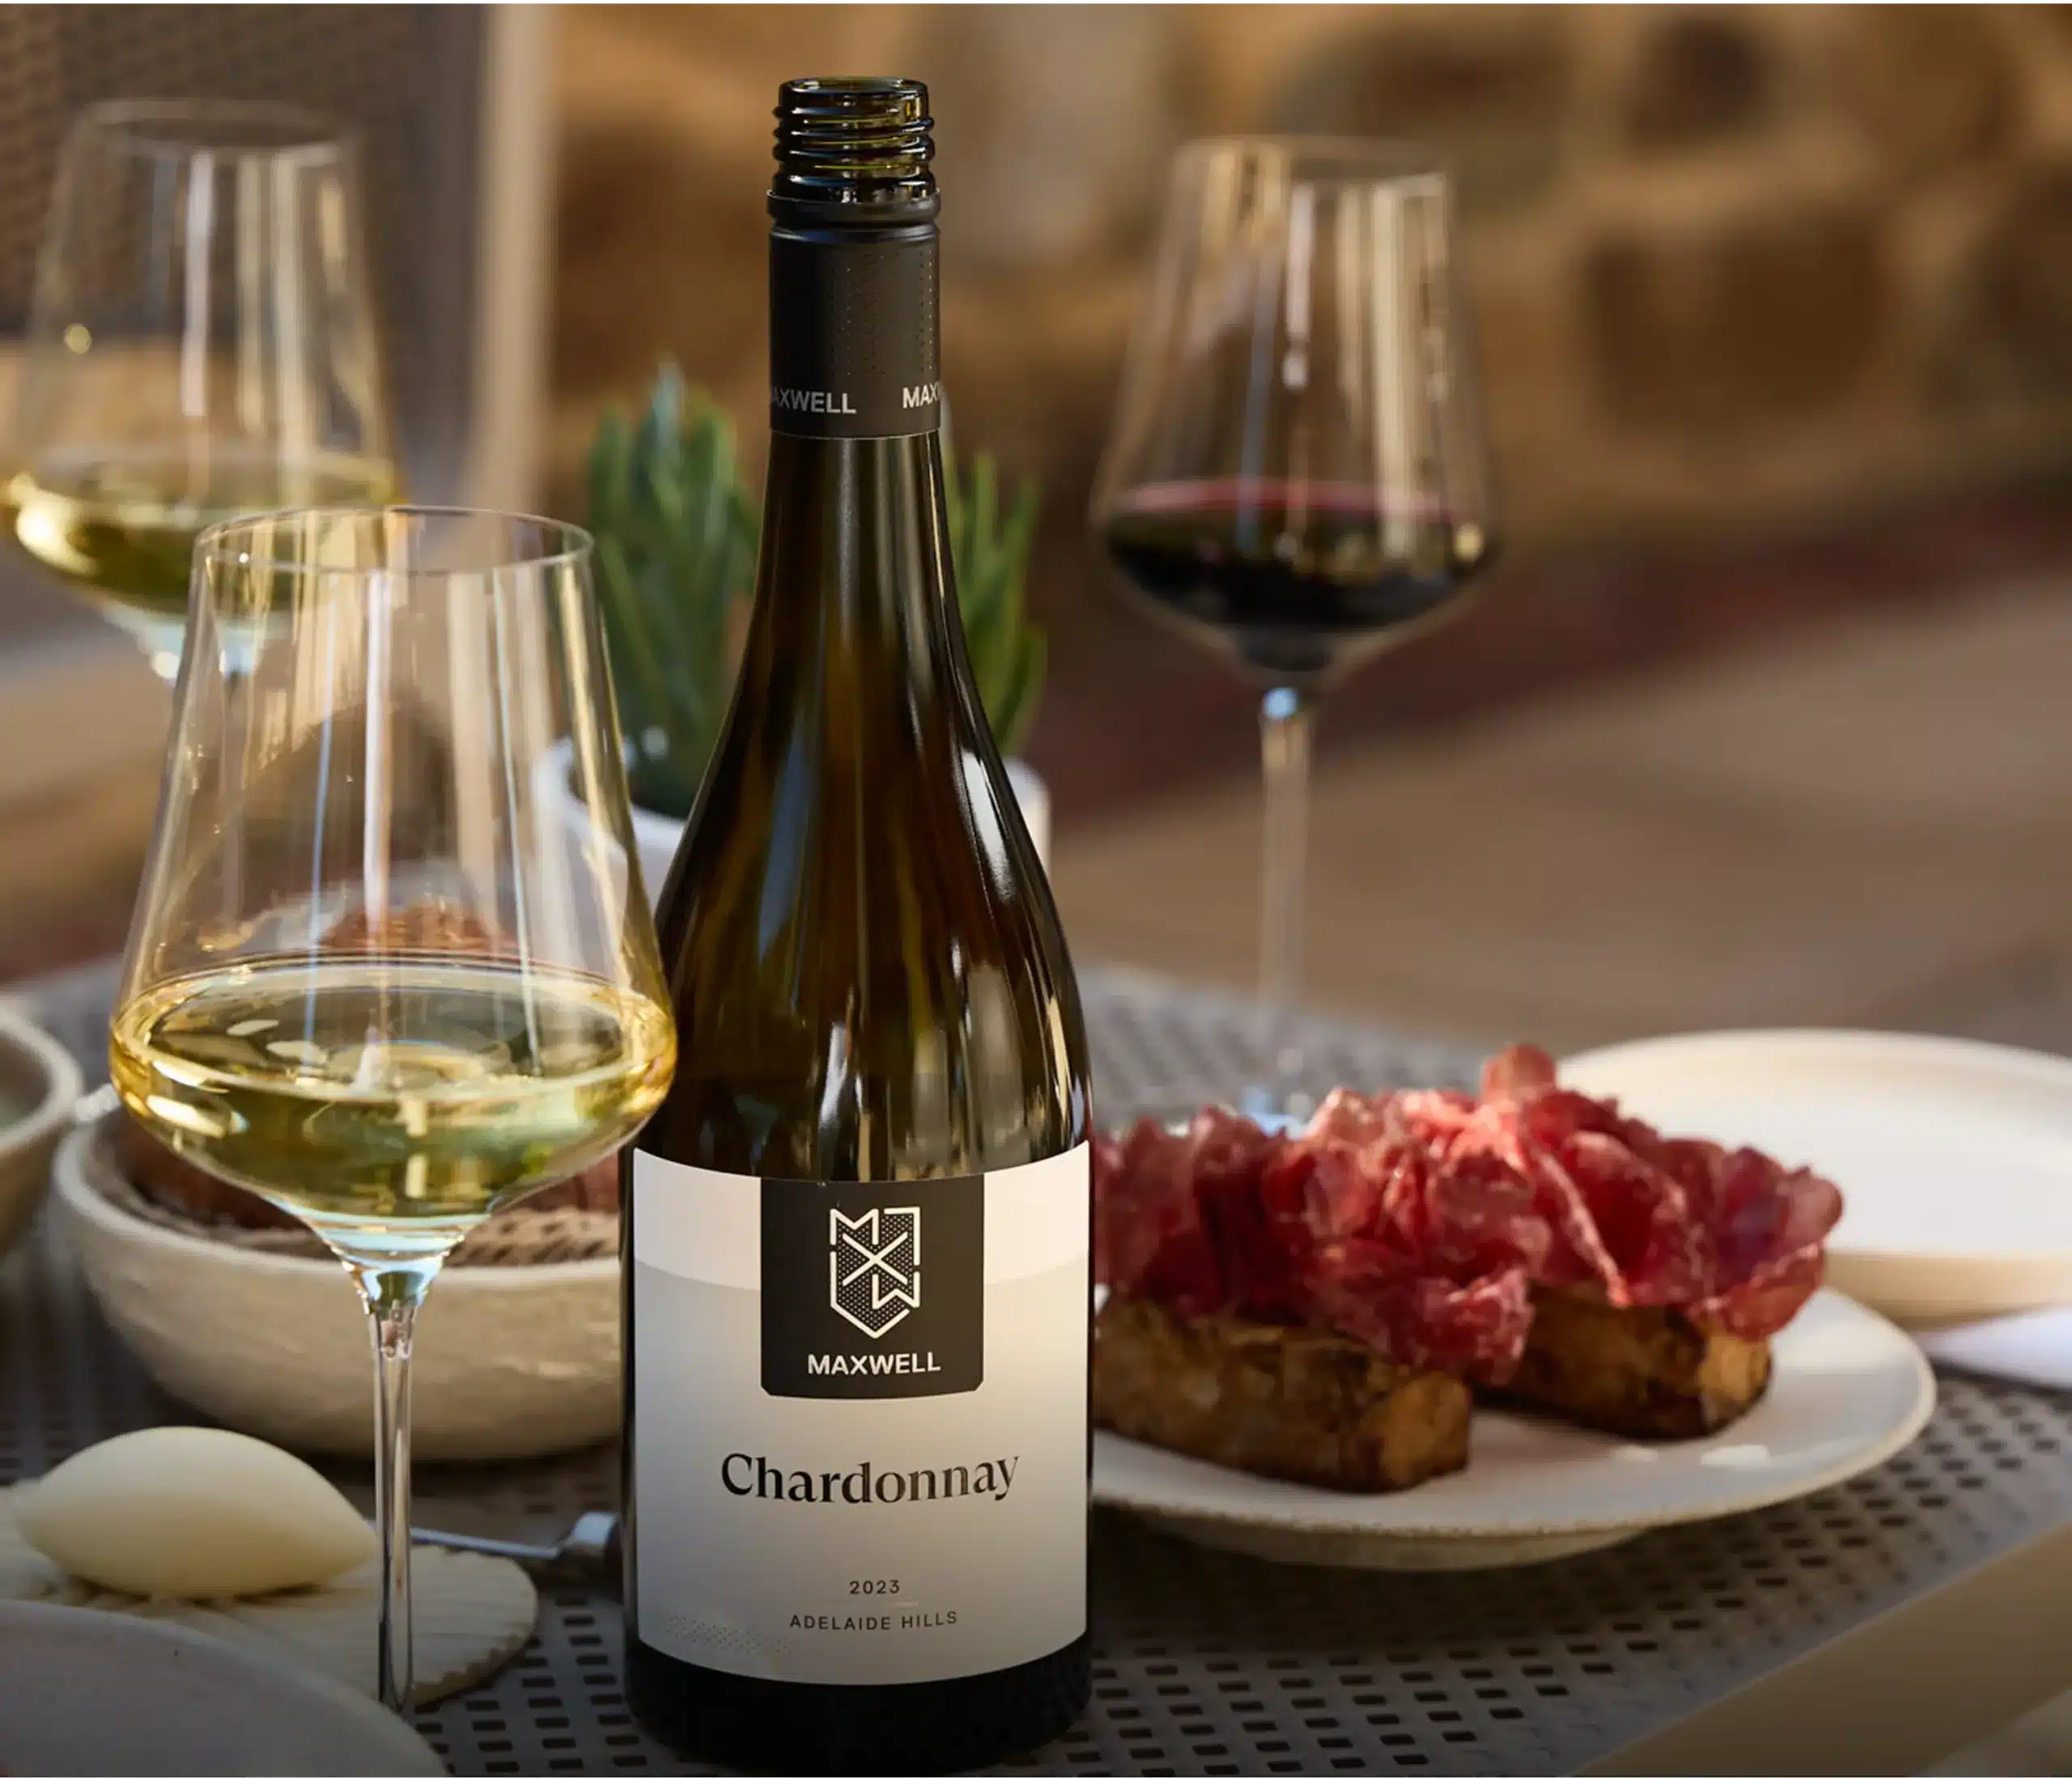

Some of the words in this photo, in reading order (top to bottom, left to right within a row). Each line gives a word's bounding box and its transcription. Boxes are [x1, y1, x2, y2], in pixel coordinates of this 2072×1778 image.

[771, 385, 857, 414] AXWELL
[808, 1352, 941, 1375] MAXWELL
[721, 1453, 1019, 1503] Chardonnay
[850, 1580, 900, 1594] 2023
[789, 1615, 891, 1631] ADELAIDE
[902, 1610, 957, 1628] HILLS
